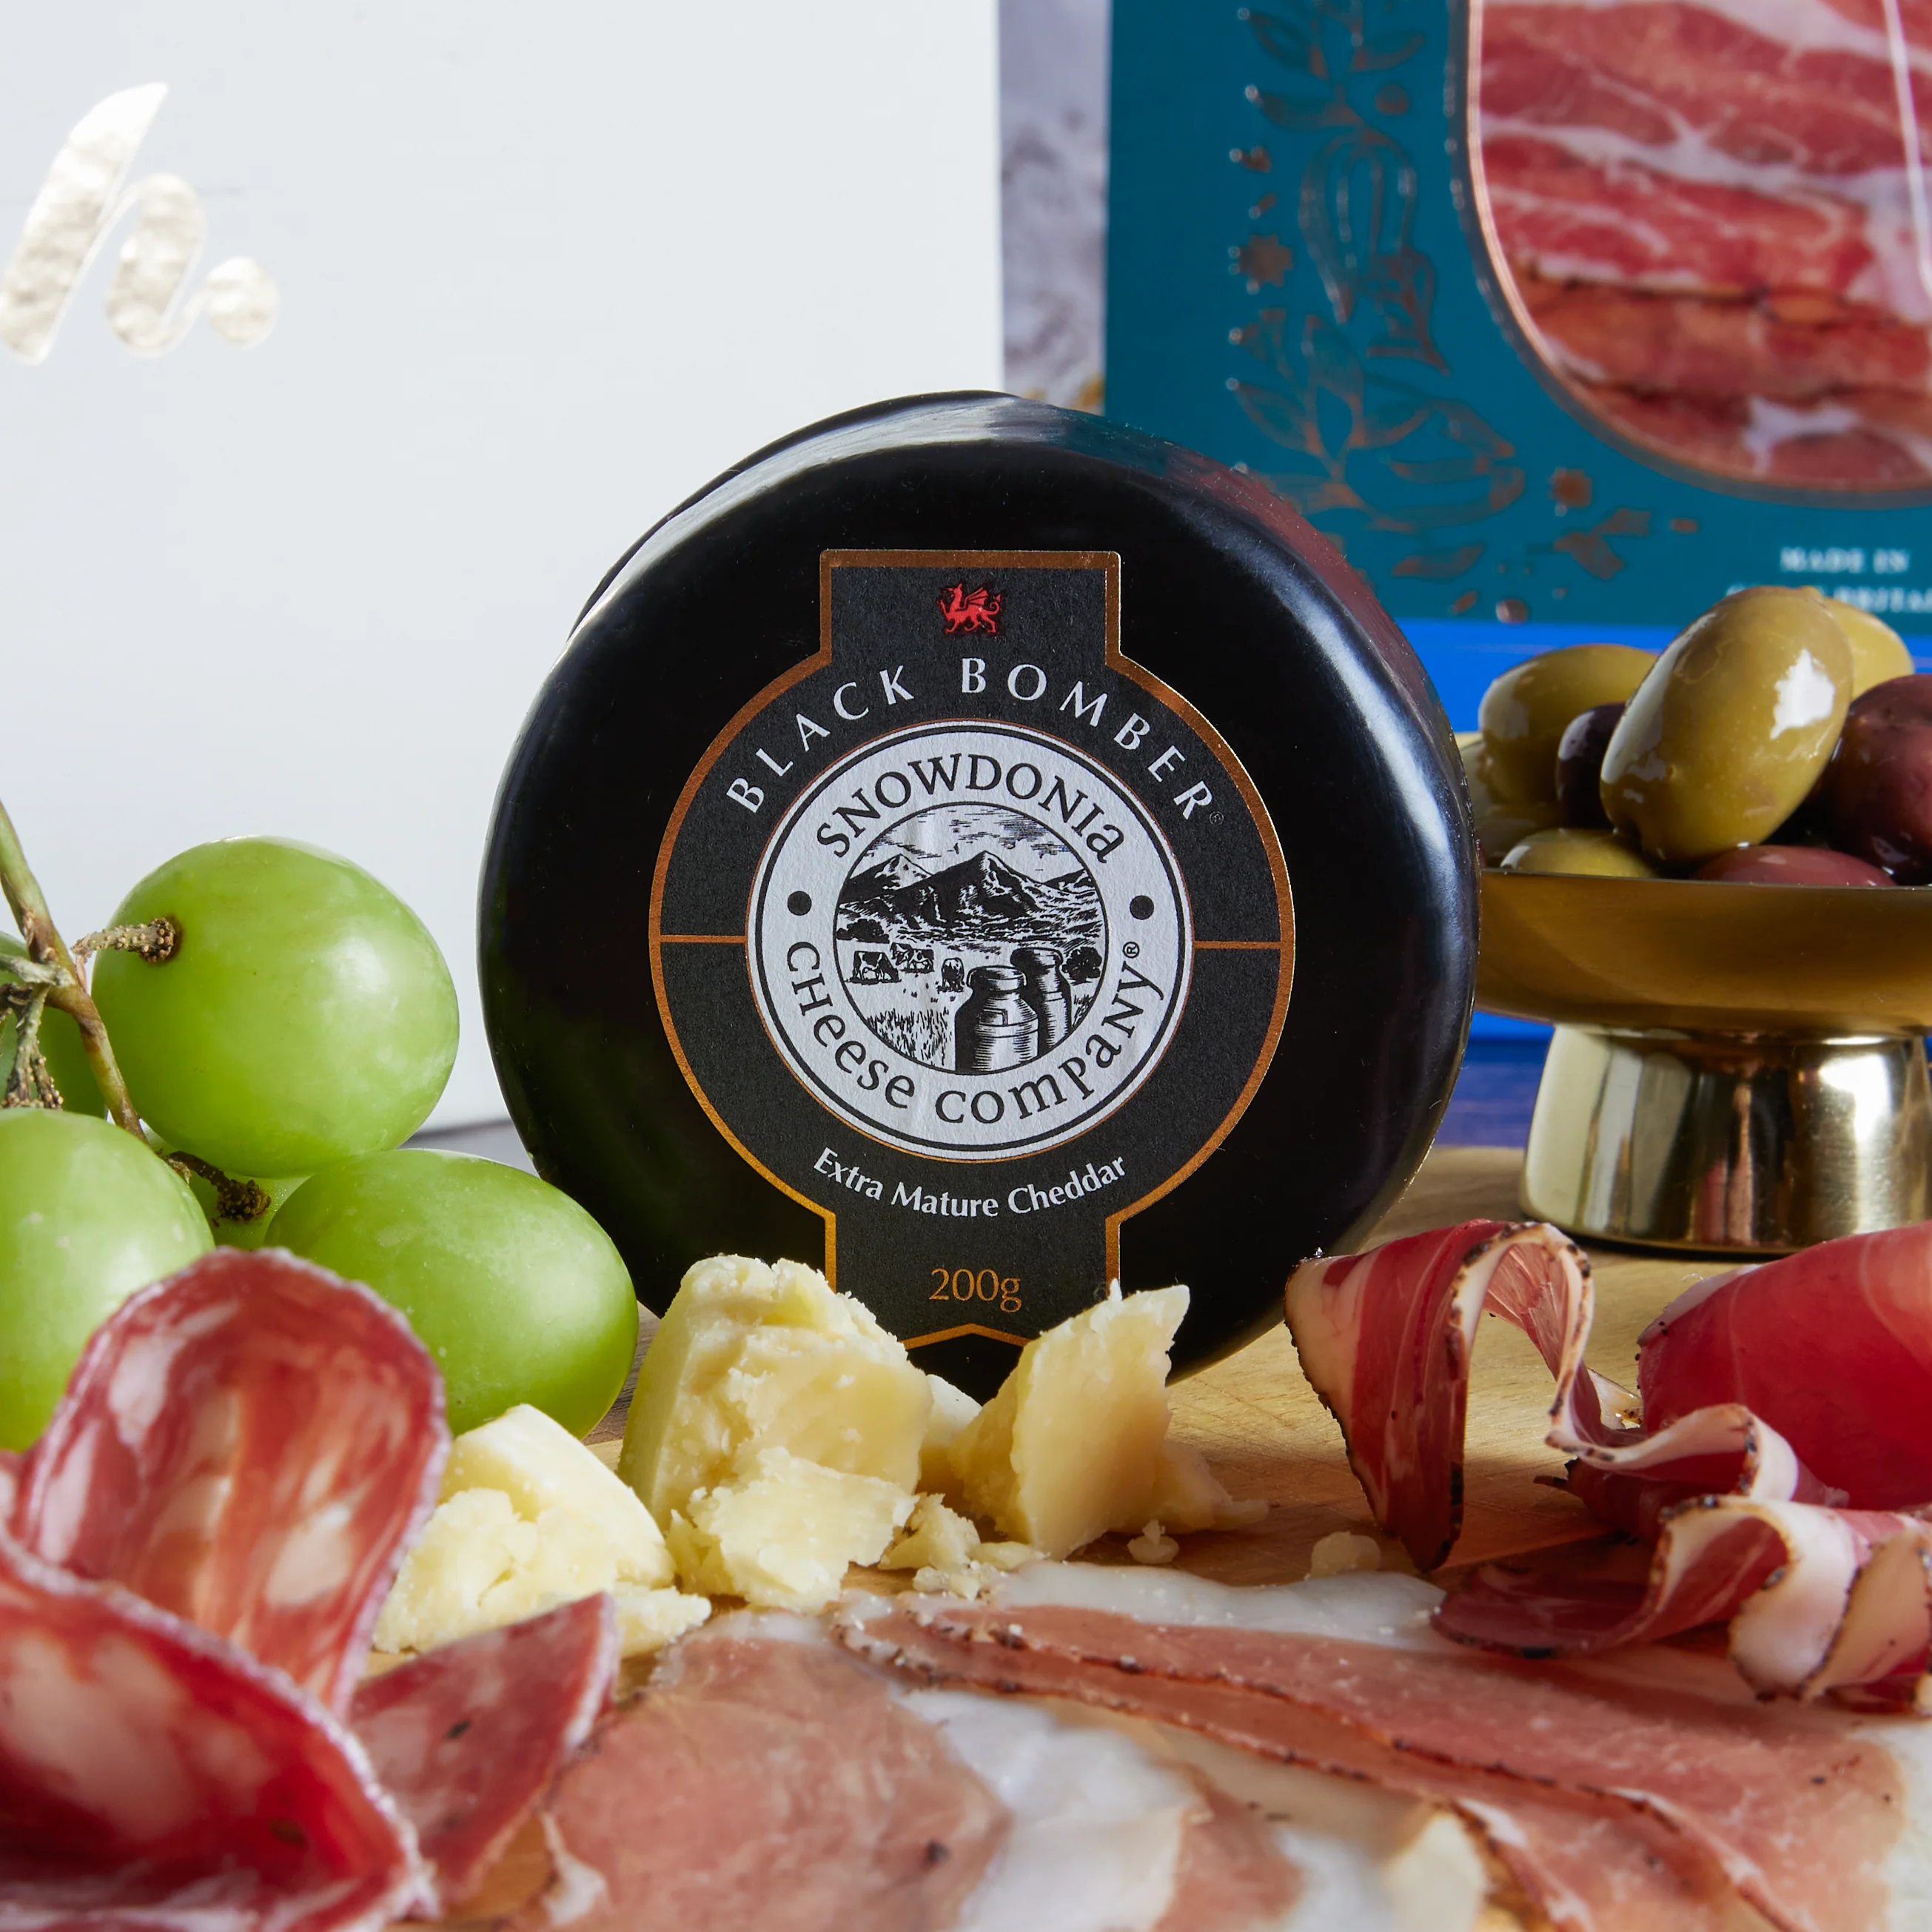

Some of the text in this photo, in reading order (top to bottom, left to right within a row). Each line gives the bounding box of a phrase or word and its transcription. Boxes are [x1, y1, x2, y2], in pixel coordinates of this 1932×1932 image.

[727, 663, 915, 814] BLACK
[814, 1147, 1126, 1218] Extra Mature Cheddar
[929, 1267, 1022, 1312] 200g
